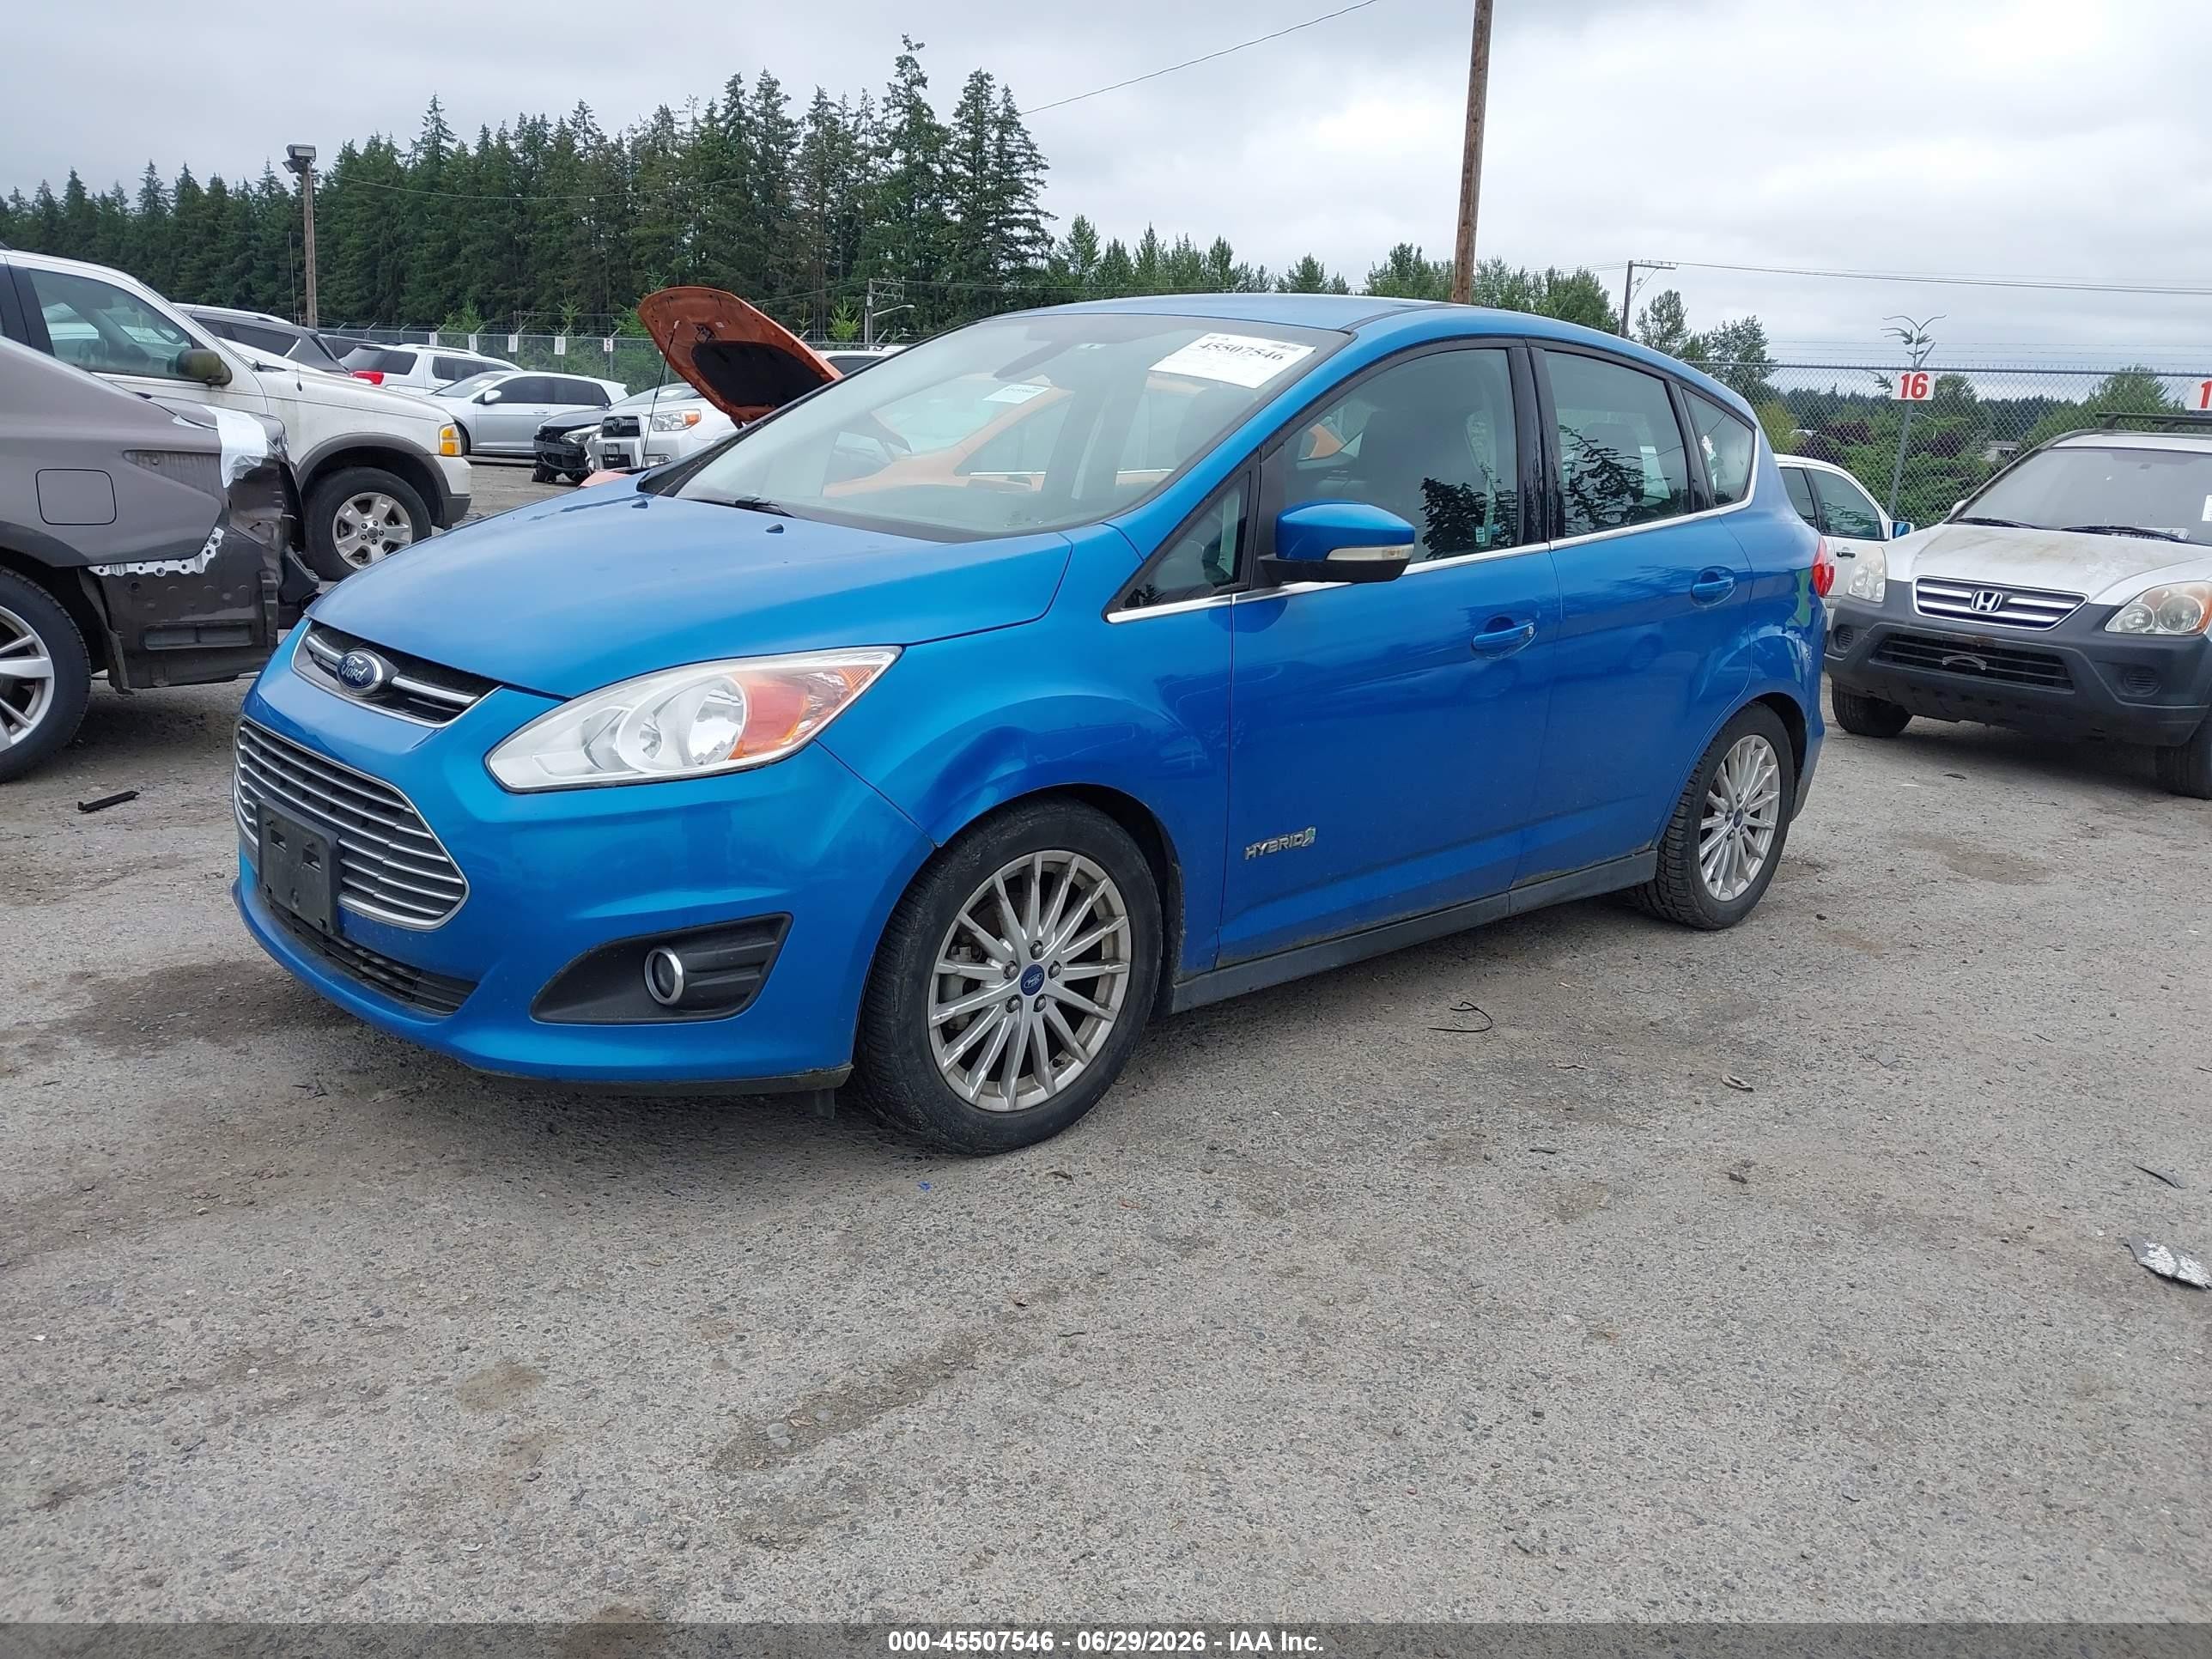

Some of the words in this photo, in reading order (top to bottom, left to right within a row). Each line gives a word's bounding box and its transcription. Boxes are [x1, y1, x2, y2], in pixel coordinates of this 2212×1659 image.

[1199, 342, 1285, 361] 45507546
[1900, 373, 1929, 399] 16
[341, 655, 368, 683] Ford
[1244, 833, 1304, 860] HYBRID
